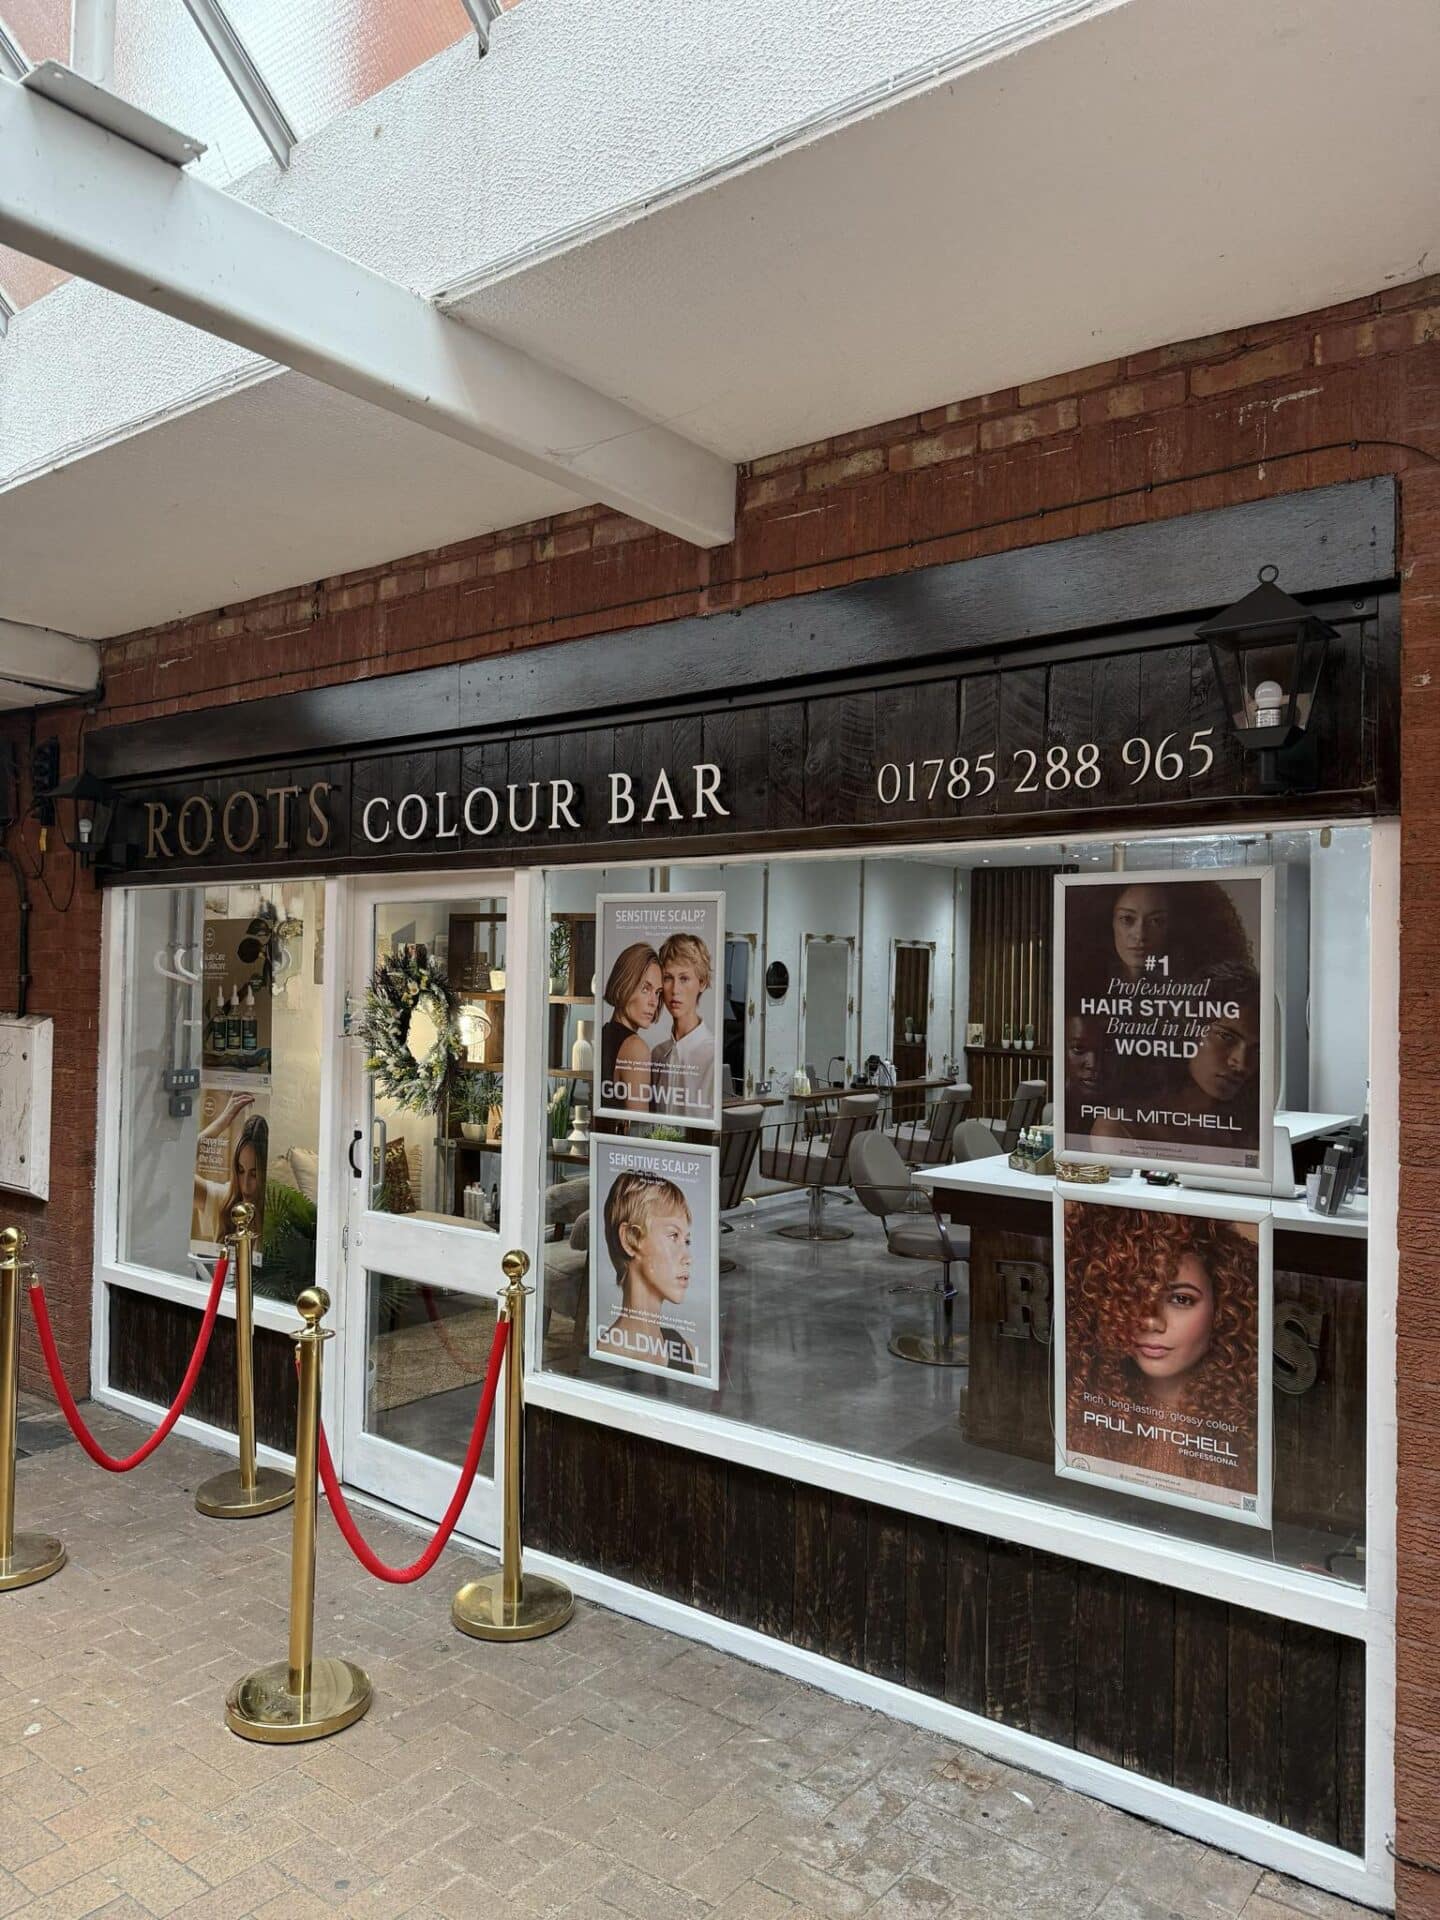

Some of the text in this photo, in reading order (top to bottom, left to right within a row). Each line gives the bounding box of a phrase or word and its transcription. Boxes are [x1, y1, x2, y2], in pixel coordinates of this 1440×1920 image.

[877, 728, 1215, 804] 01785 288 965
[143, 763, 731, 859] ROOTS COLOUR BAR
[616, 909, 706, 922] SENSITIVE SCALP?
[1145, 955, 1169, 976] #1
[1107, 977, 1211, 999] Professional
[1081, 998, 1240, 1019] HAIR STYLING
[1106, 1017, 1211, 1037] Brand in the
[601, 1080, 711, 1108] GOLDWELL
[1081, 1105, 1243, 1131] PAUL MITCHELL
[609, 1152, 700, 1175] SENSITIVE SCALP?
[598, 1324, 709, 1368] GOLDWELL
[1169, 1410, 1203, 1427] glossy
[1205, 1417, 1239, 1433] colour
[1083, 1411, 1239, 1457] PAUL MITCHELL
[1178, 1448, 1240, 1468] PROFESSIONAL
